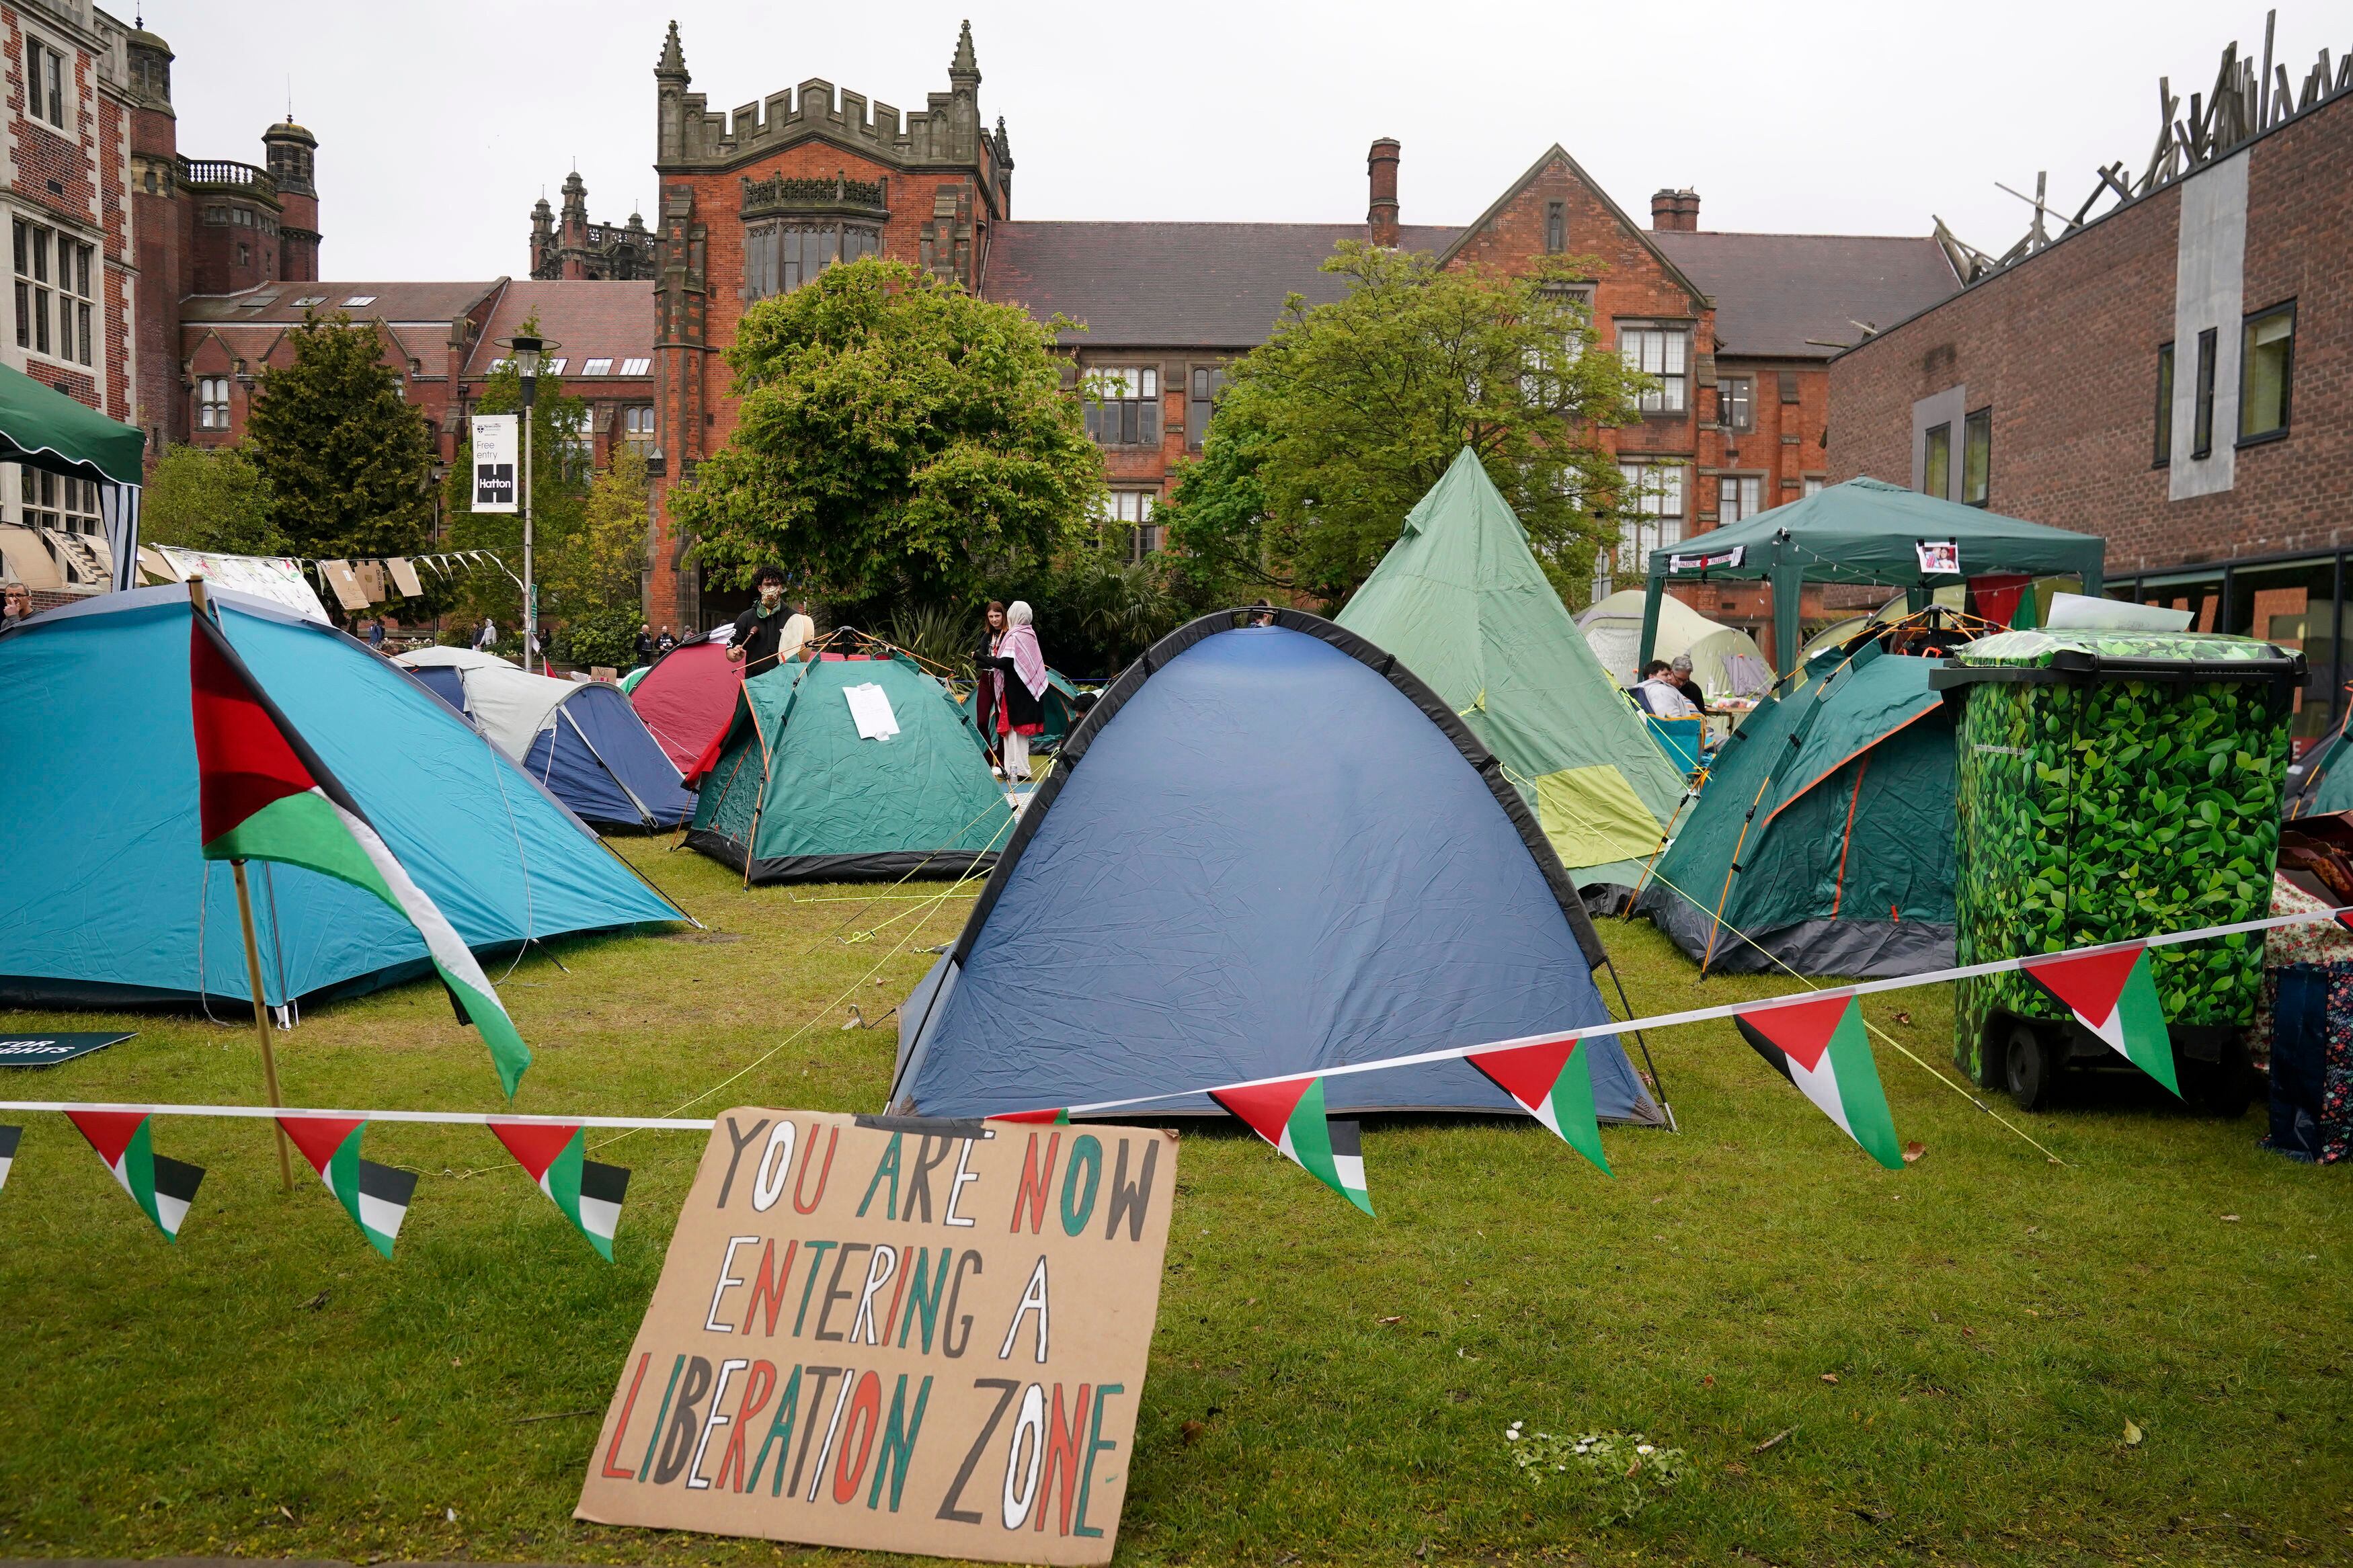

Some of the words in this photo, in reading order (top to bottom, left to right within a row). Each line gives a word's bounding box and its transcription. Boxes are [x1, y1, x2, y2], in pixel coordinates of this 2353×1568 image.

[477, 441, 495, 449] Free
[477, 451, 497, 460] entry
[479, 479, 511, 488] Hatton
[1711, 555, 1730, 564] PALESTINE
[715, 1117, 840, 1214] YOU
[856, 1129, 996, 1227] ARE
[1009, 1132, 1160, 1241] NOW
[703, 1235, 983, 1359] ENTERING
[999, 1255, 1049, 1364] A
[601, 1352, 934, 1513] LIBERATION
[934, 1378, 1126, 1538] ZONE
